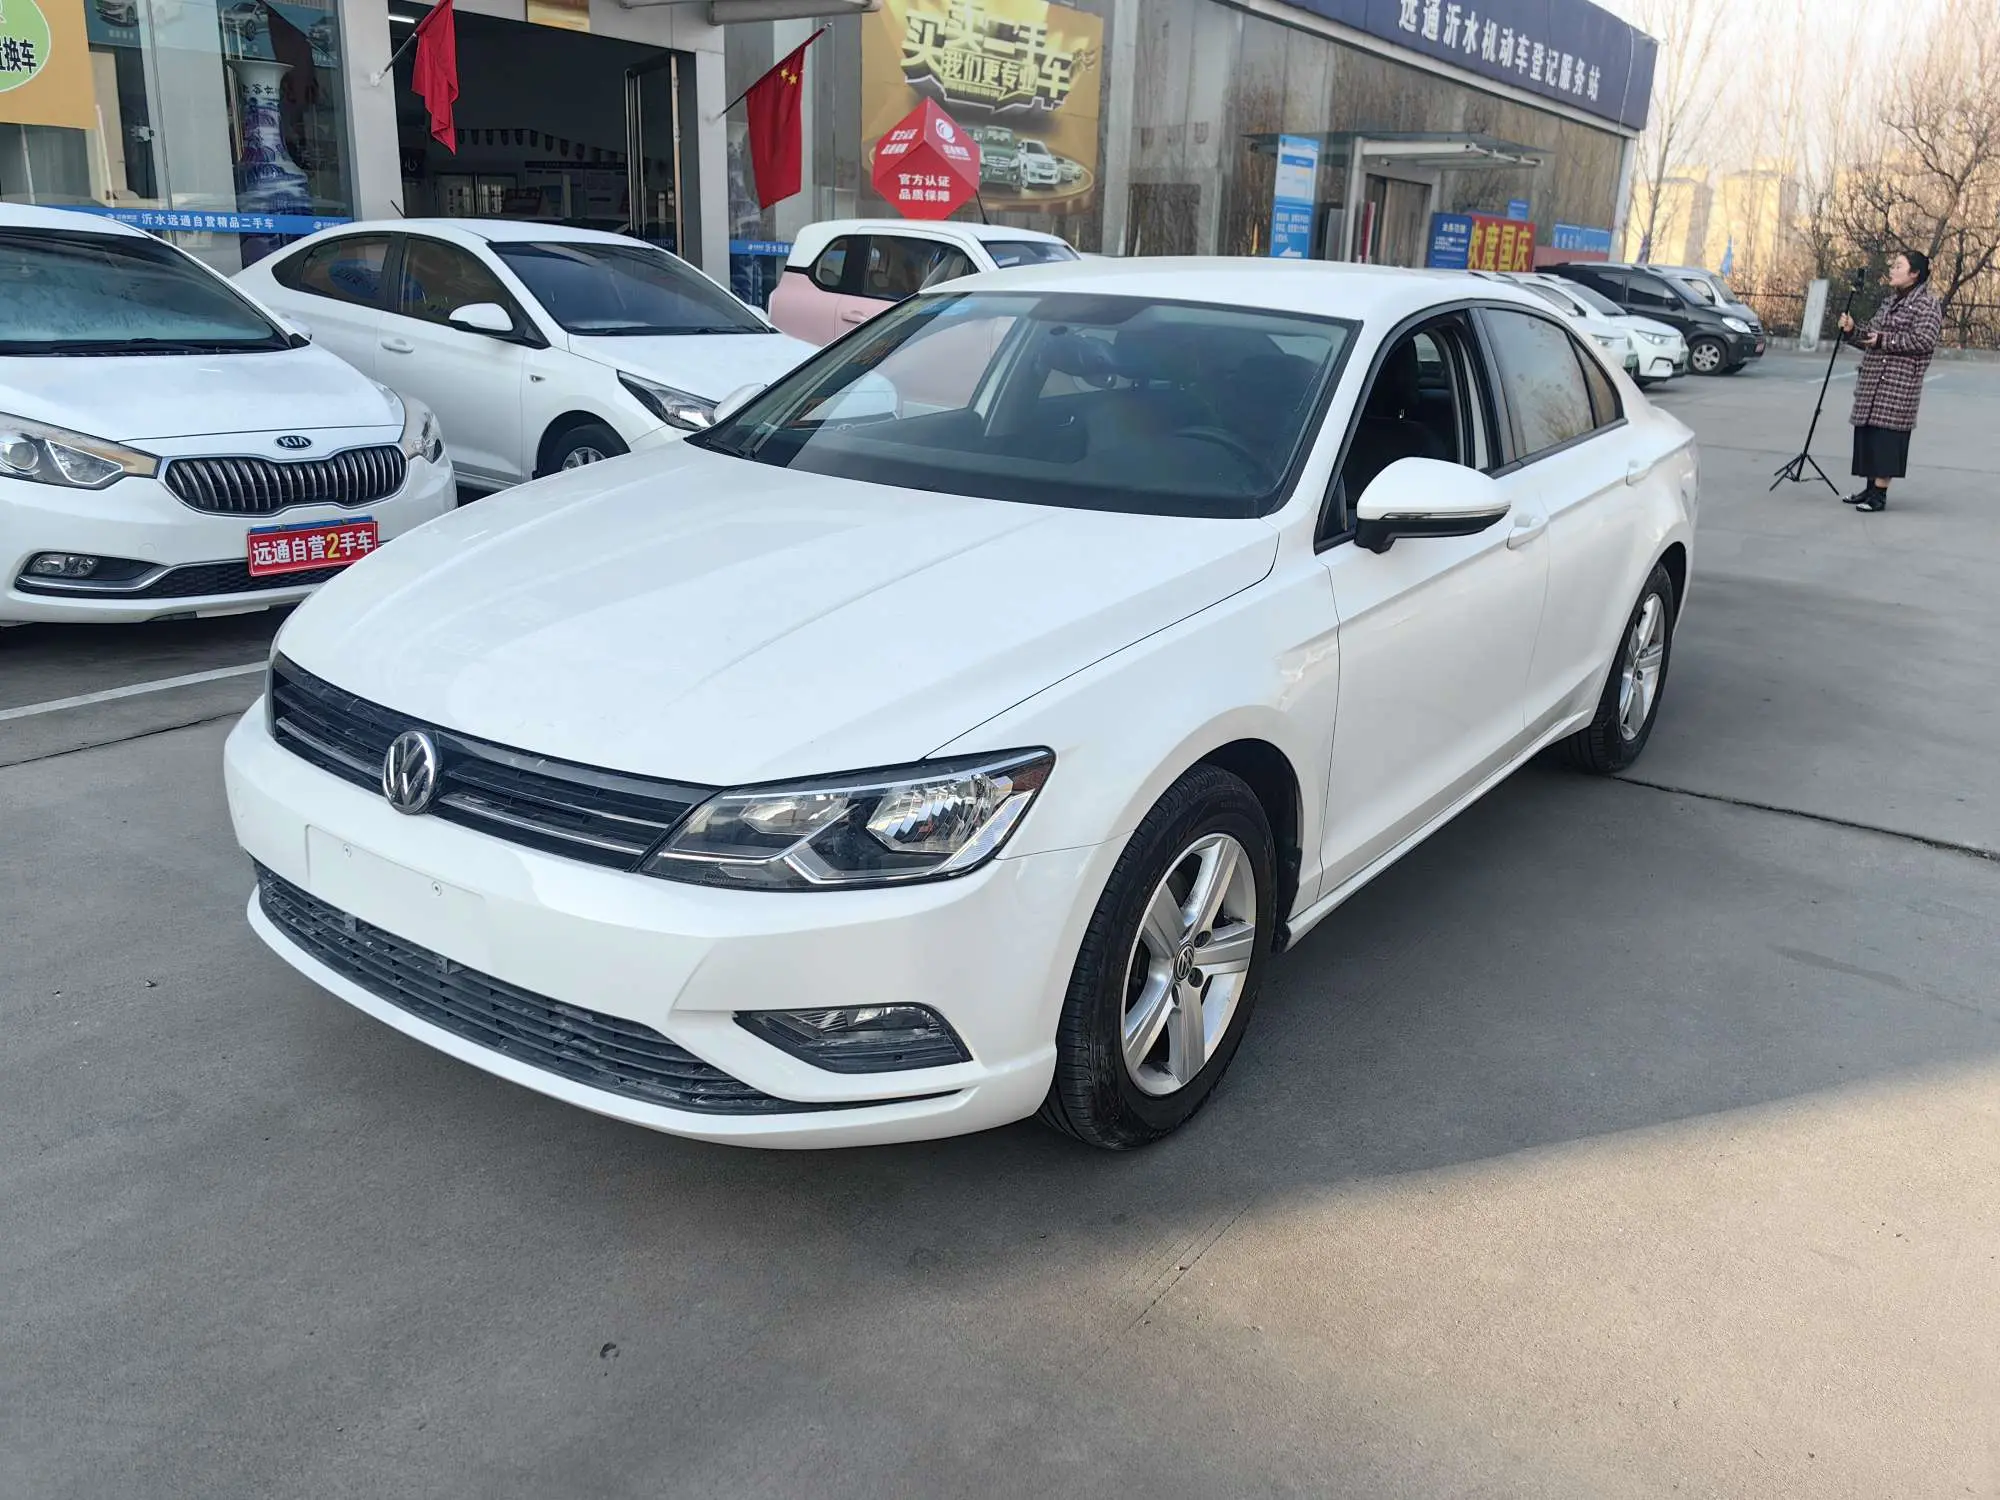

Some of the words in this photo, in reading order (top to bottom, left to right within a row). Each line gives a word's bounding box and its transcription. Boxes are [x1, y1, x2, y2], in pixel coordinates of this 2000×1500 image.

[1399, 0, 1601, 101] 远通沂水机动车登记服务站
[942, 51, 1039, 94] 我们更专业
[898, 173, 950, 188] 官方认证
[898, 188, 950, 203] 品质保障
[141, 212, 275, 230] 沂水远通自营精品二手车
[281, 436, 309, 448] KIA
[253, 531, 374, 565] 远通自营2手车
